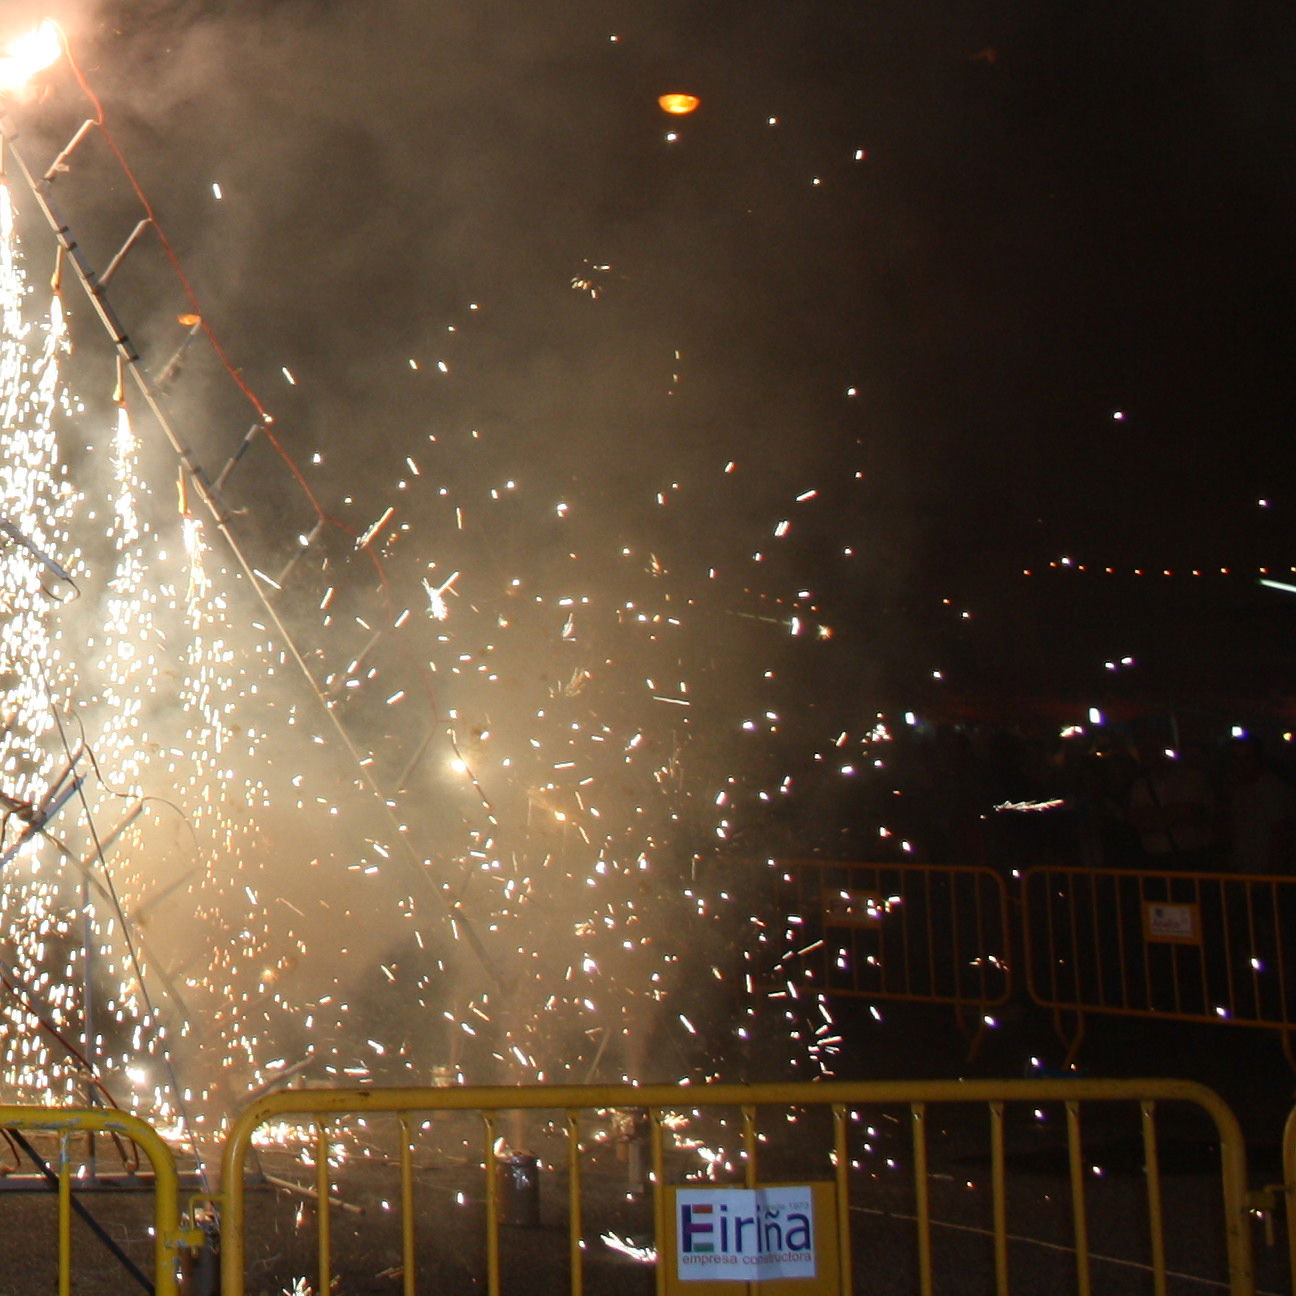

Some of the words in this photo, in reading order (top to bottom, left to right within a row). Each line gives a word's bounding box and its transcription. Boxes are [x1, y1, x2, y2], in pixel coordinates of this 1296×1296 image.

[681, 1203, 811, 1253] Eiriña
[682, 1254, 738, 1265] empresa
[742, 1251, 812, 1264] constructora
